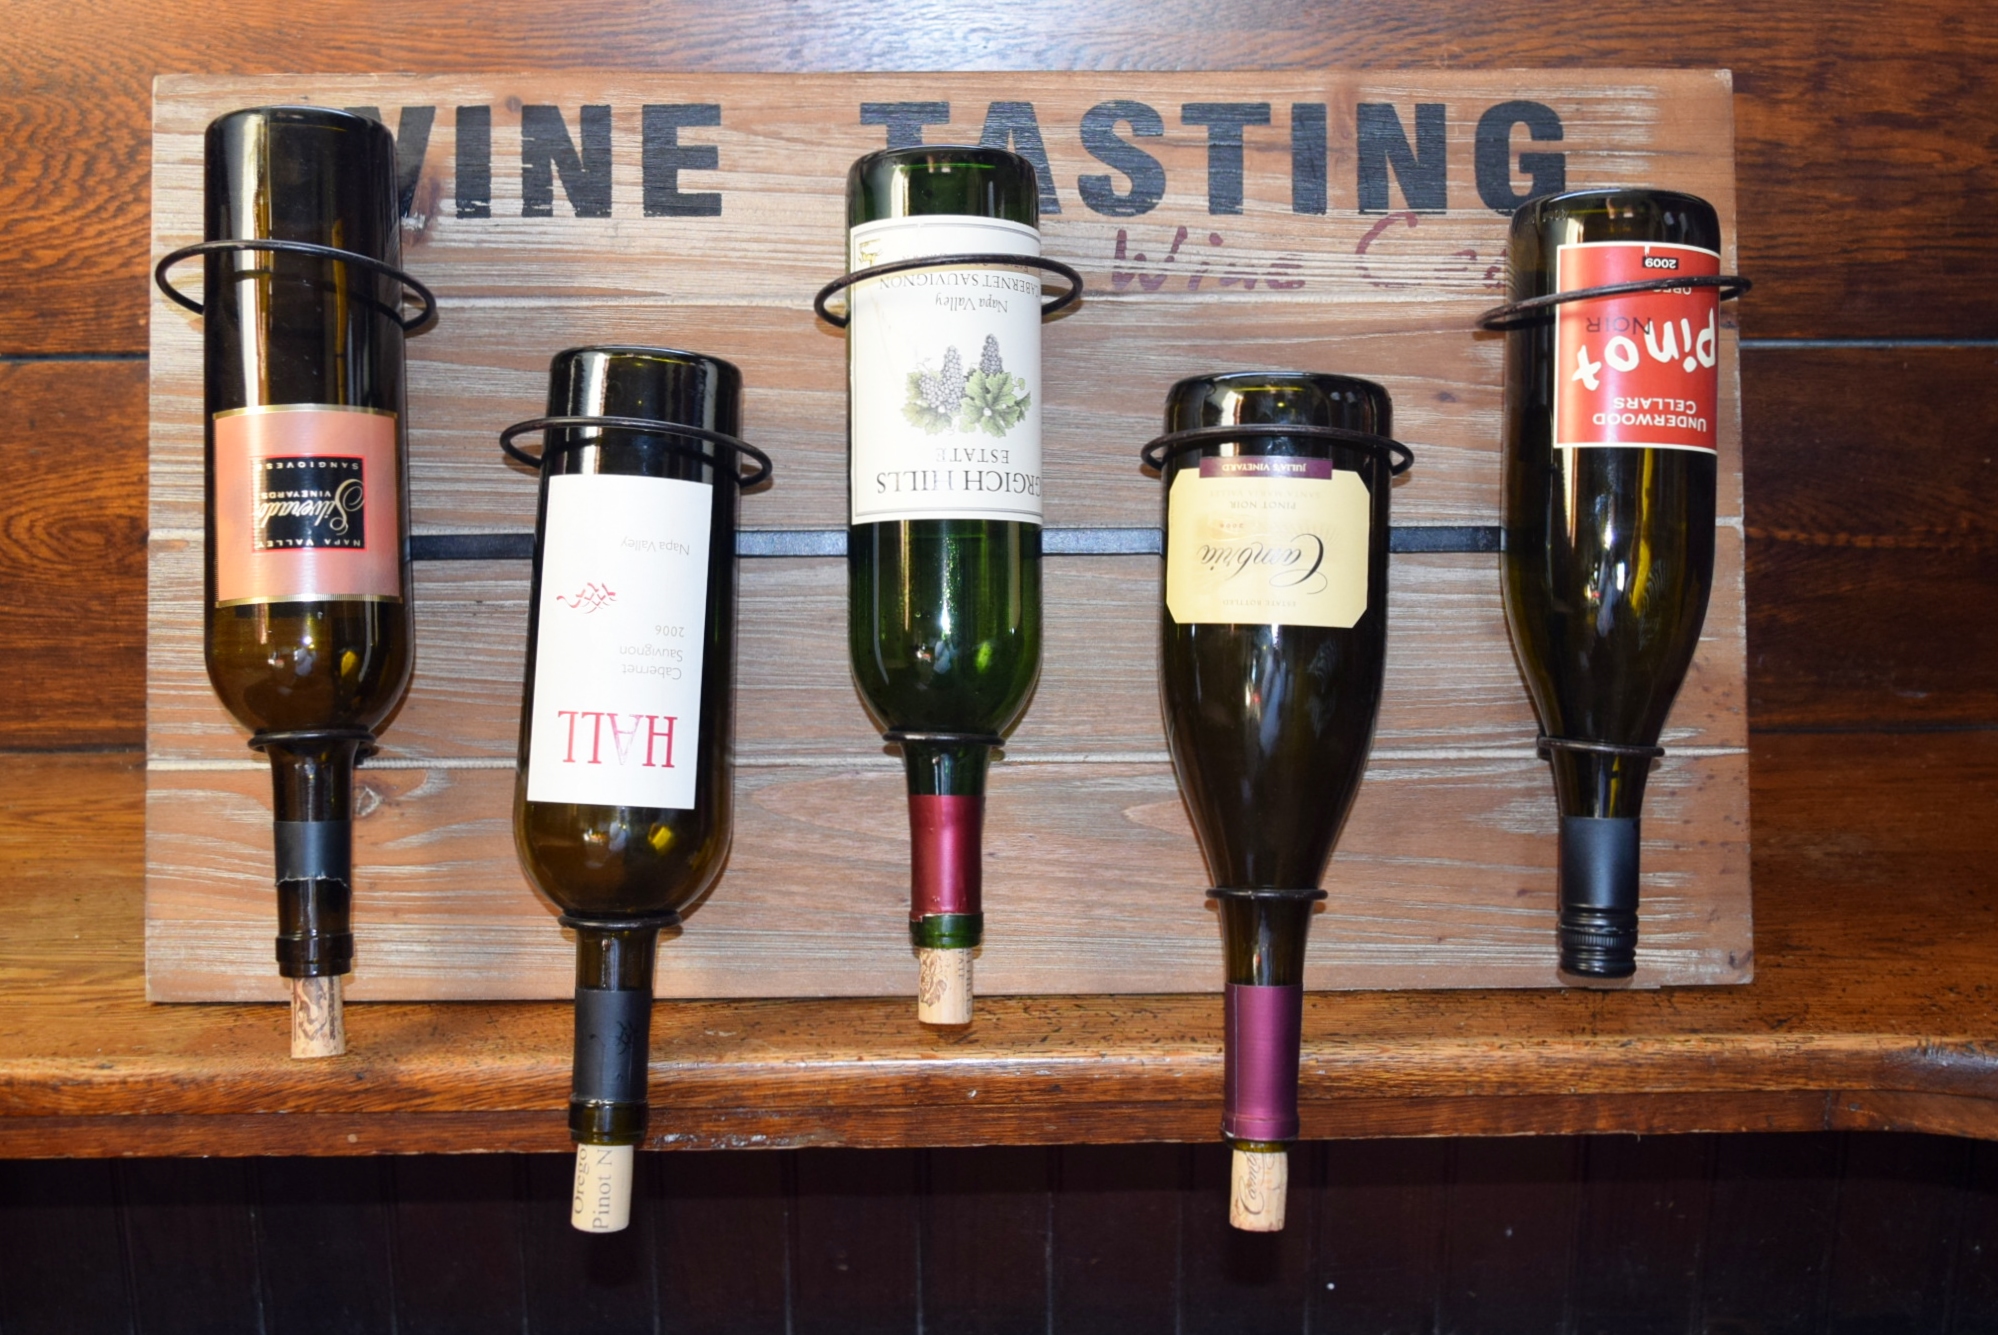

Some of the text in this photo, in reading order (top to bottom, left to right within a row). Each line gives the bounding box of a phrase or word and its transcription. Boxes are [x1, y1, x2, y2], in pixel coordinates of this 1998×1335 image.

[860, 101, 1565, 216] TASTING
[1645, 258, 1676, 268] 2009
[879, 272, 979, 290] SAUVIGNON
[935, 292, 1008, 313] Napa Valley
[1586, 317, 1651, 335] NOIR
[1613, 397, 1697, 414] CELLARS
[1593, 413, 1706, 432] UNDERWOOD
[935, 447, 1010, 464] ESTATE
[1222, 463, 1307, 472] JULIA'S VINEYARD
[876, 470, 1041, 497] GRGICH HILLS
[259, 490, 331, 499] VINEYARDS
[252, 478, 363, 536] Silverado
[1229, 501, 1296, 509] PINOT NOIR
[254, 538, 361, 548] NAPA VALLEY
[621, 536, 690, 556] Napa Valley
[1197, 533, 1327, 595] Cambria
[655, 625, 684, 637] 2006
[619, 643, 684, 662] Sauvignon
[622, 662, 682, 680] Cabernet
[558, 710, 678, 769] HALL
[575, 1144, 589, 1213] Orego
[593, 1175, 611, 1229] Pinot
